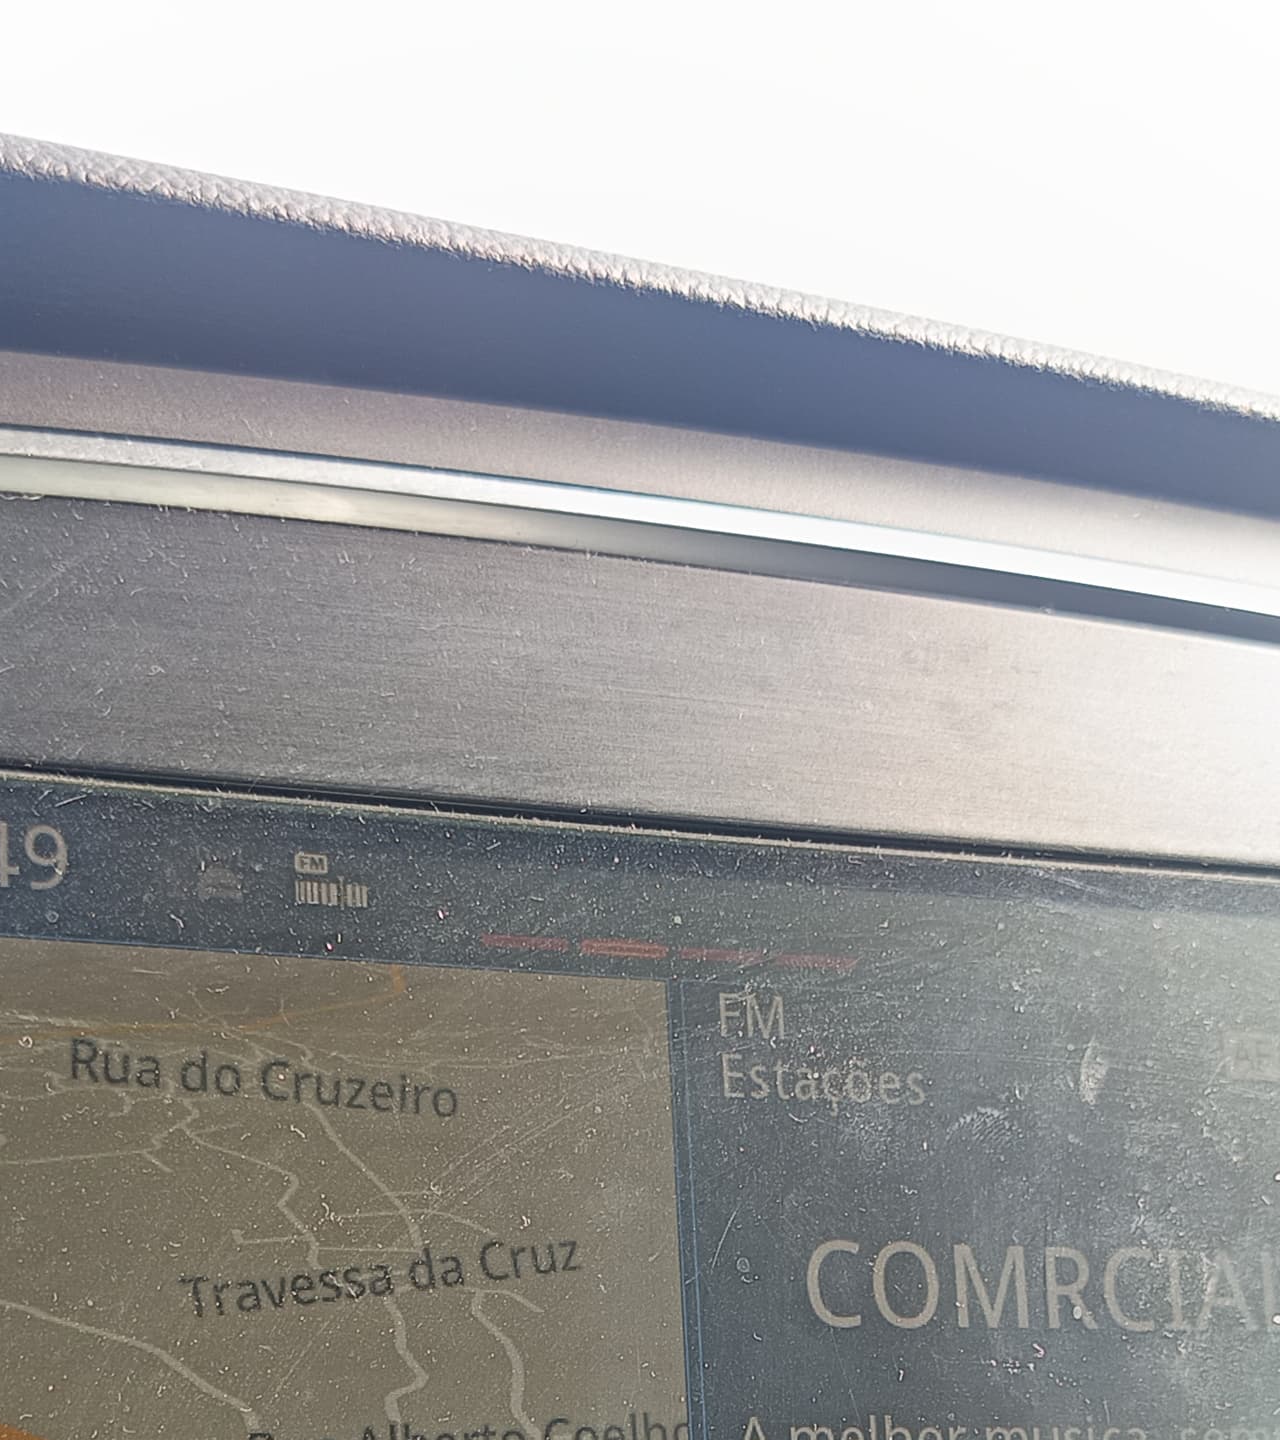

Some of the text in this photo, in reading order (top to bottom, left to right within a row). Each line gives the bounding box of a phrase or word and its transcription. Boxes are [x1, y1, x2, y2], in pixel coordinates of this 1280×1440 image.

[718, 991, 786, 1040] FM
[70, 1036, 460, 1119] Rua do Cruzeiro
[720, 1052, 926, 1117] Estações
[180, 1236, 582, 1318] Travessa da Cruz
